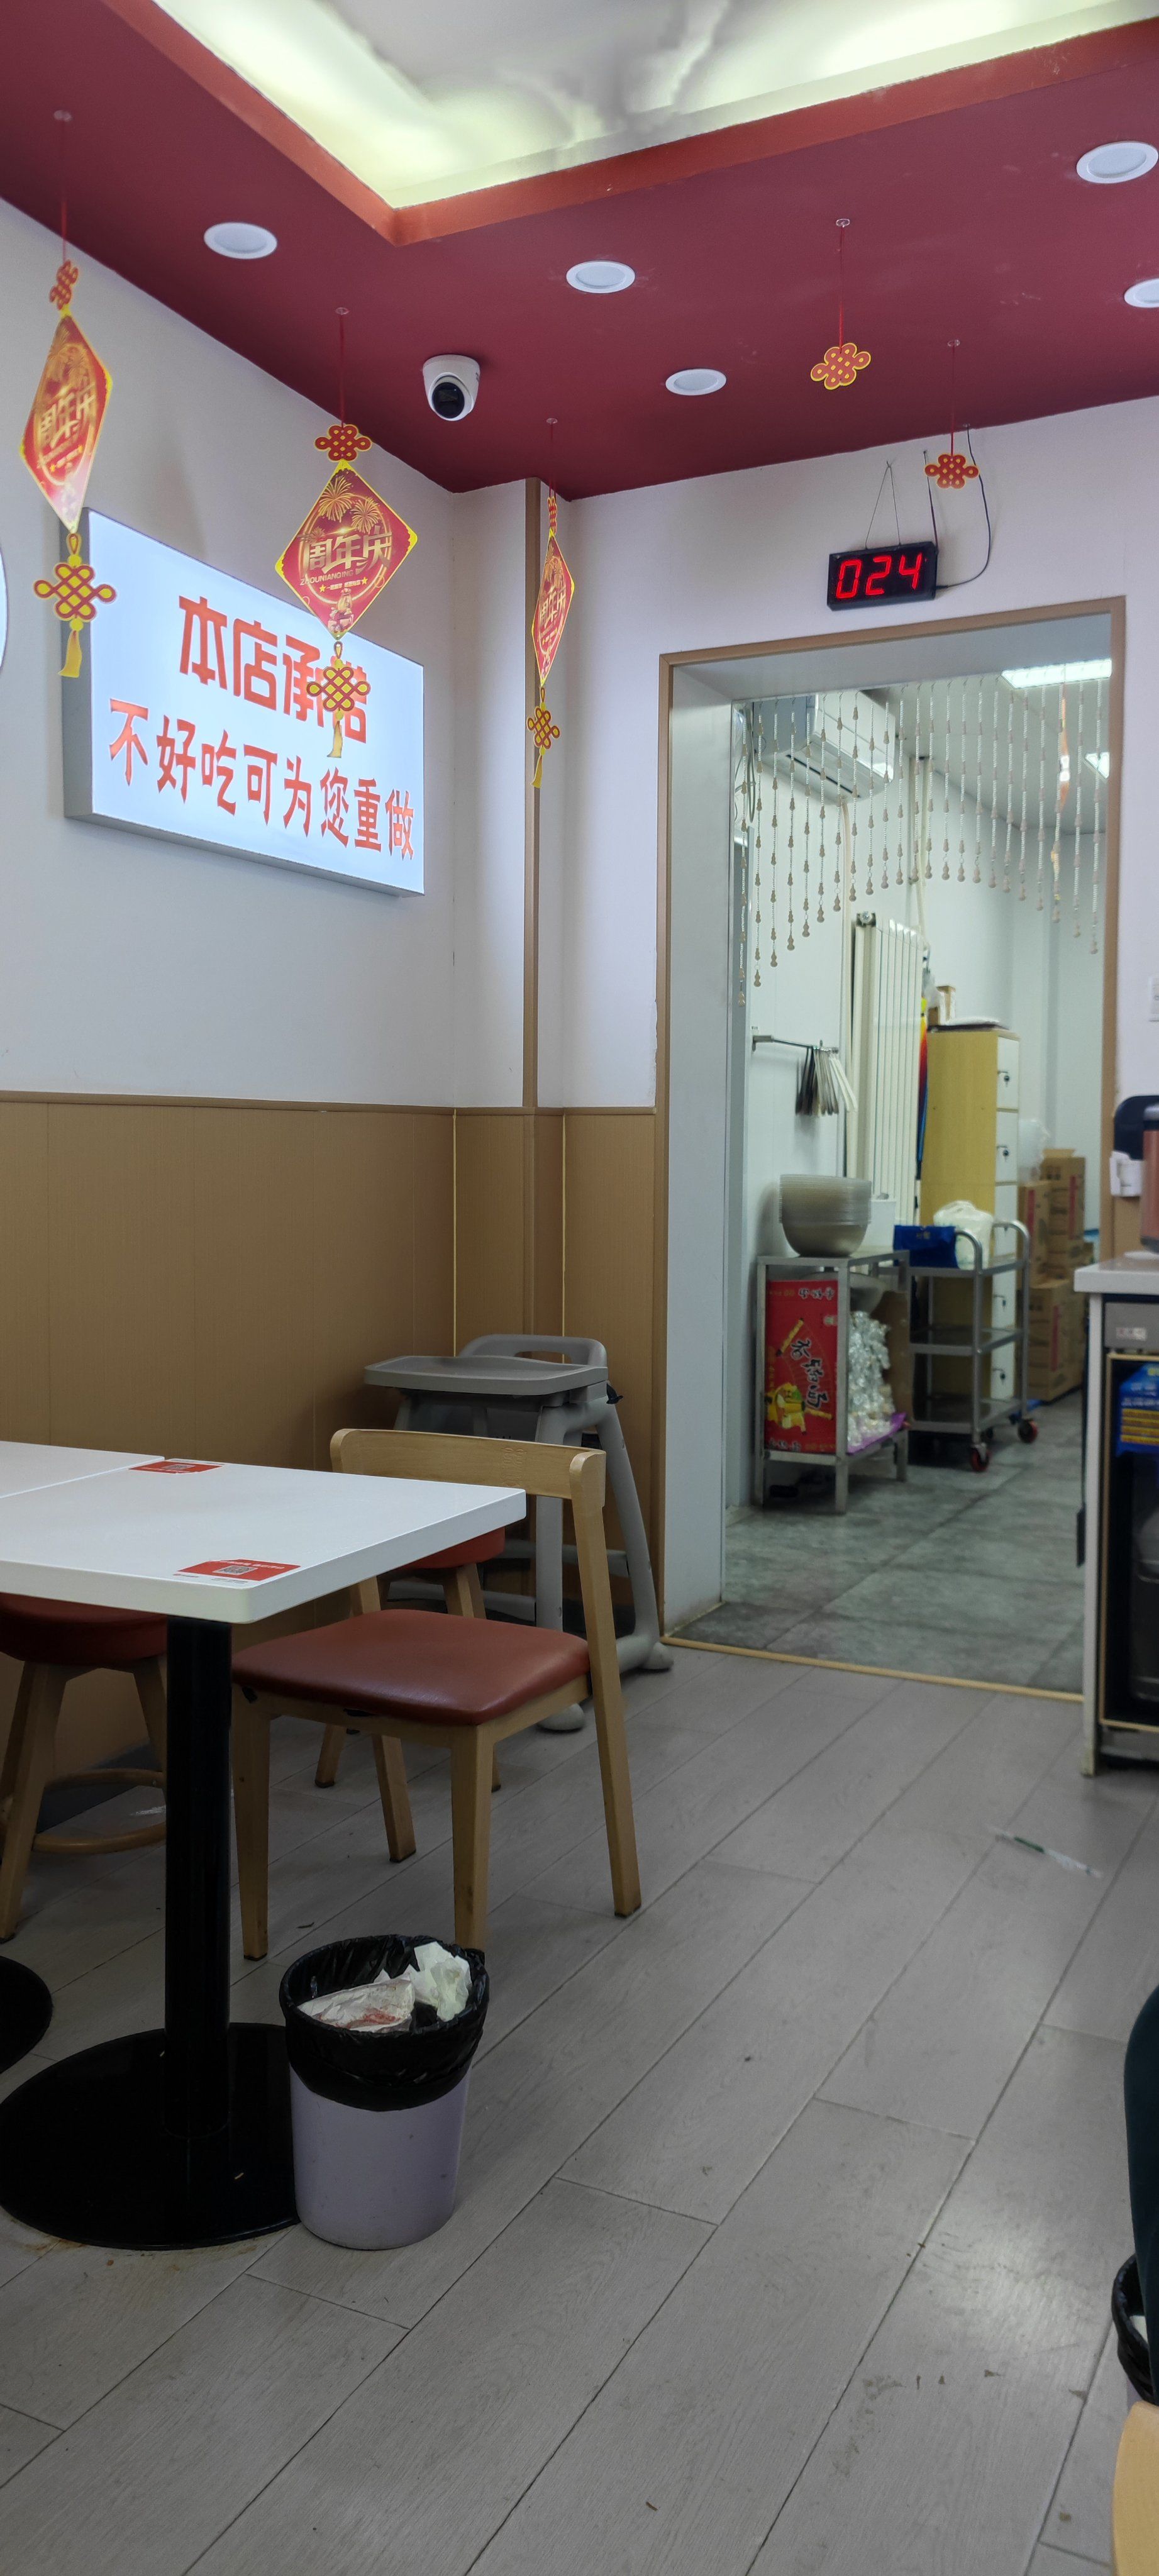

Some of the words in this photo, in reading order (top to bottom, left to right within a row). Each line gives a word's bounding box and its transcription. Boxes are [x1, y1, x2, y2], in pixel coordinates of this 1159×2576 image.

[302, 525, 392, 575] 周年庆
[836, 552, 923, 599] 024
[109, 697, 415, 861] 不好吃可为您重做
